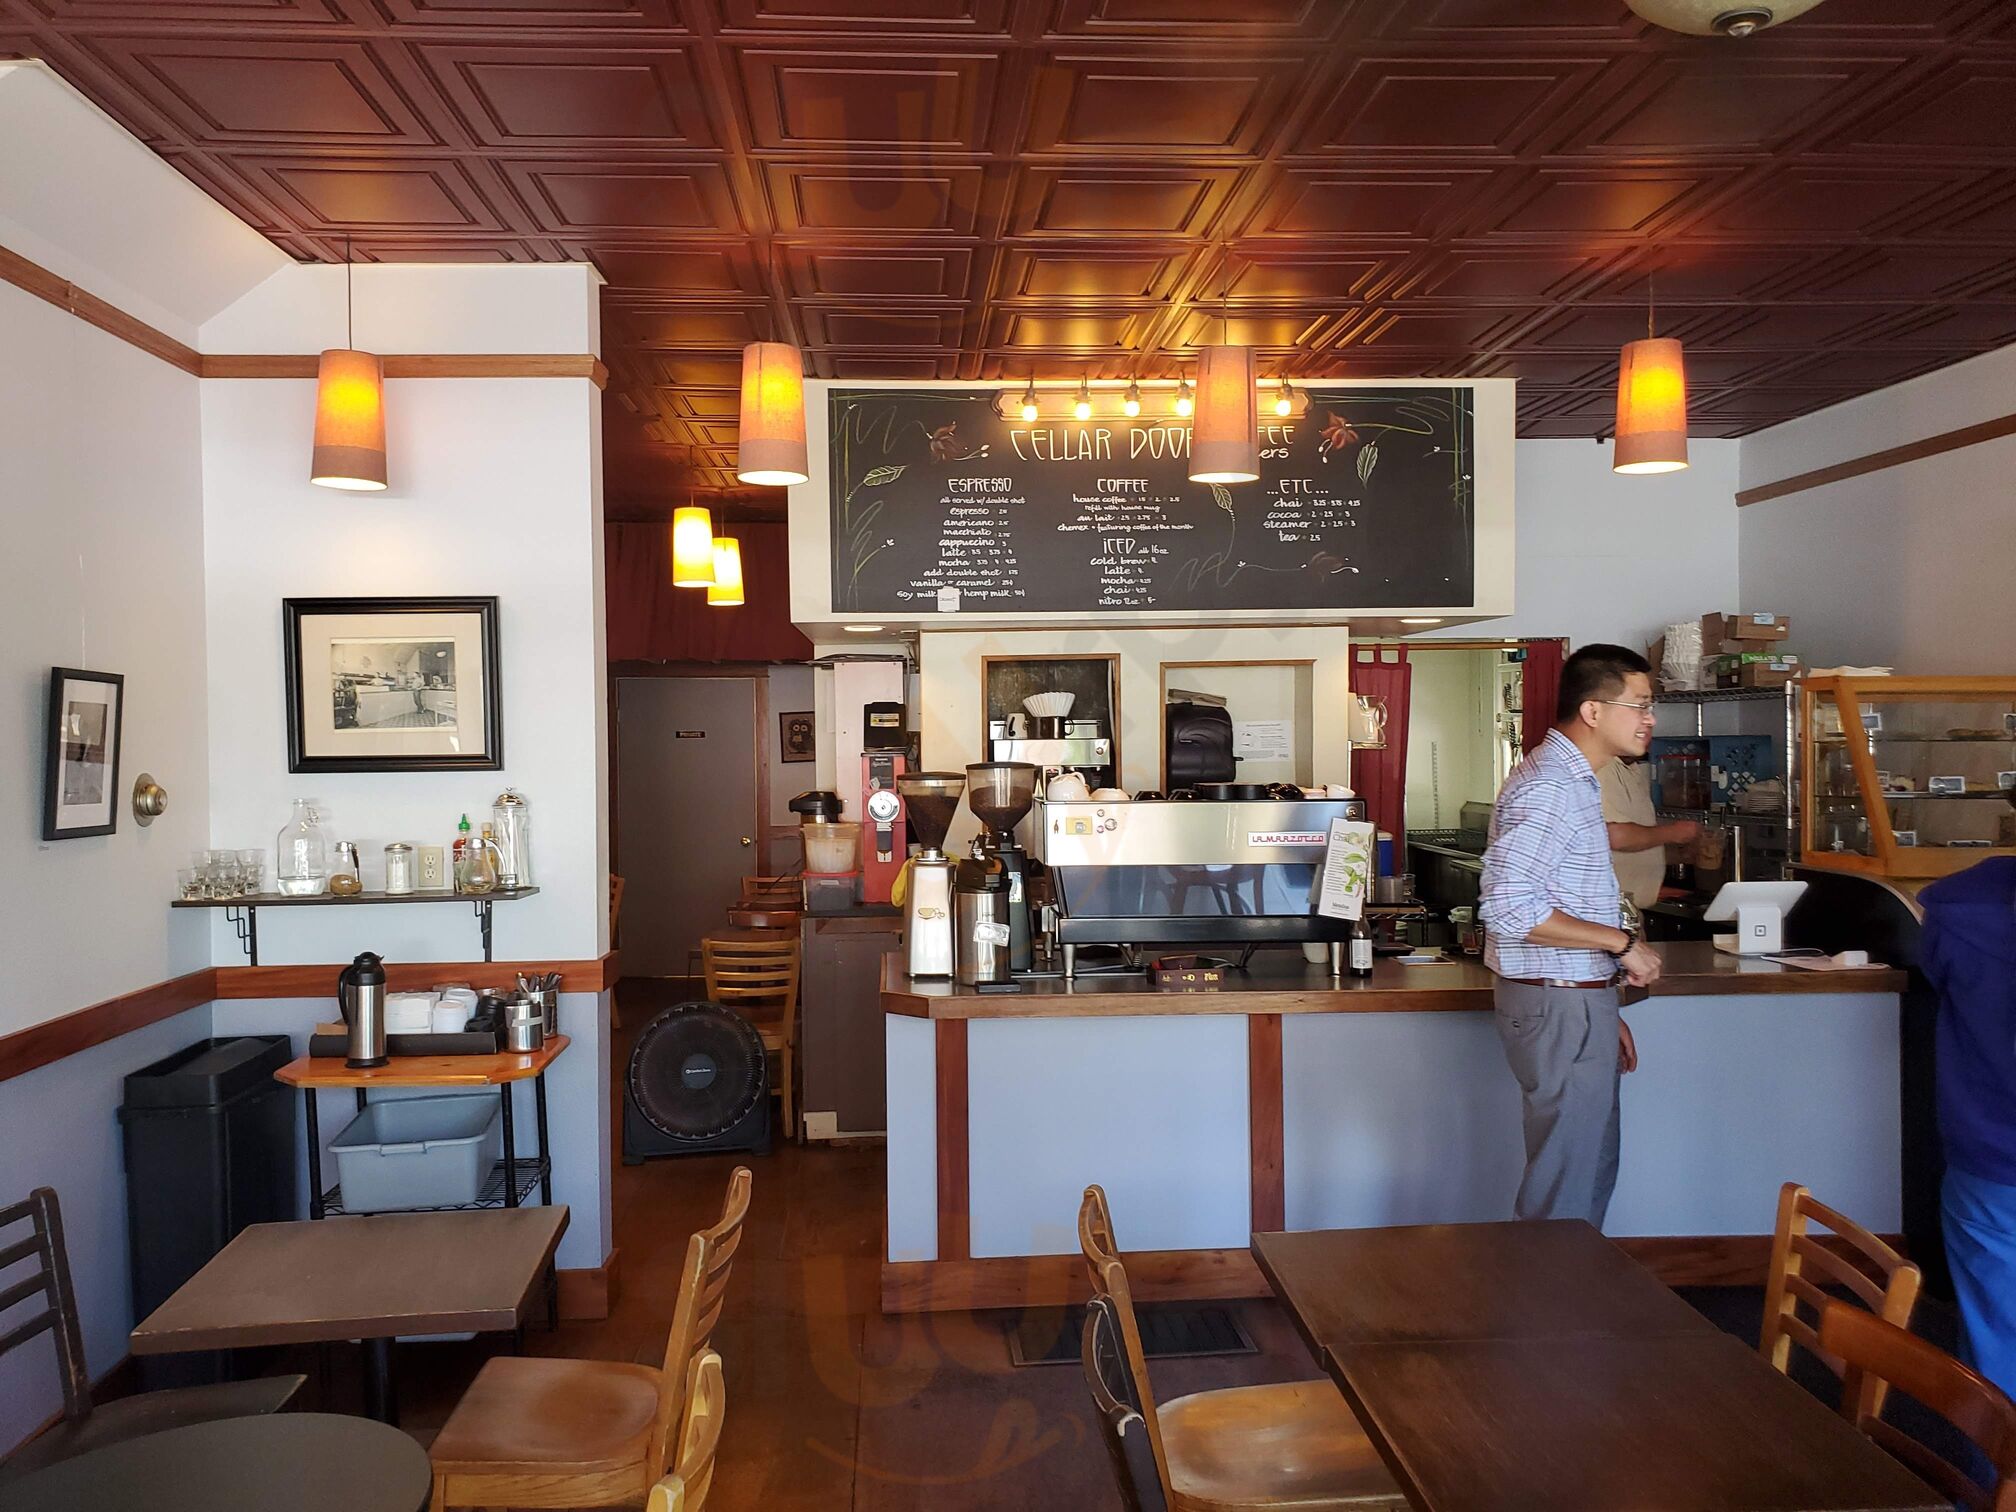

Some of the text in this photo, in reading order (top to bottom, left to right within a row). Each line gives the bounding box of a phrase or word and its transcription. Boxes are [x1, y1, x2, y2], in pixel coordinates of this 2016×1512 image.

[1010, 428, 1112, 461] CELLAR
[948, 478, 1012, 493] ESPRESSO
[1097, 478, 1148, 493] COFFEE
[1073, 493, 1100, 503] house
[1102, 496, 1127, 504] coffee
[1274, 498, 1303, 507] chai
[950, 507, 989, 518] espresso
[1279, 530, 1299, 541] tea
[939, 538, 995, 548] cappuccino
[942, 547, 967, 557] latte
[939, 559, 971, 567] mocha
[1090, 557, 1117, 565] cold
[1121, 557, 1147, 565] brew
[1105, 566, 1131, 575] latte
[910, 579, 946, 587] vanilla
[956, 579, 995, 587] caramel
[1101, 577, 1136, 585] mocha
[964, 589, 989, 600] hemp
[1104, 586, 1131, 594] chai
[1098, 597, 1122, 605] nitro
